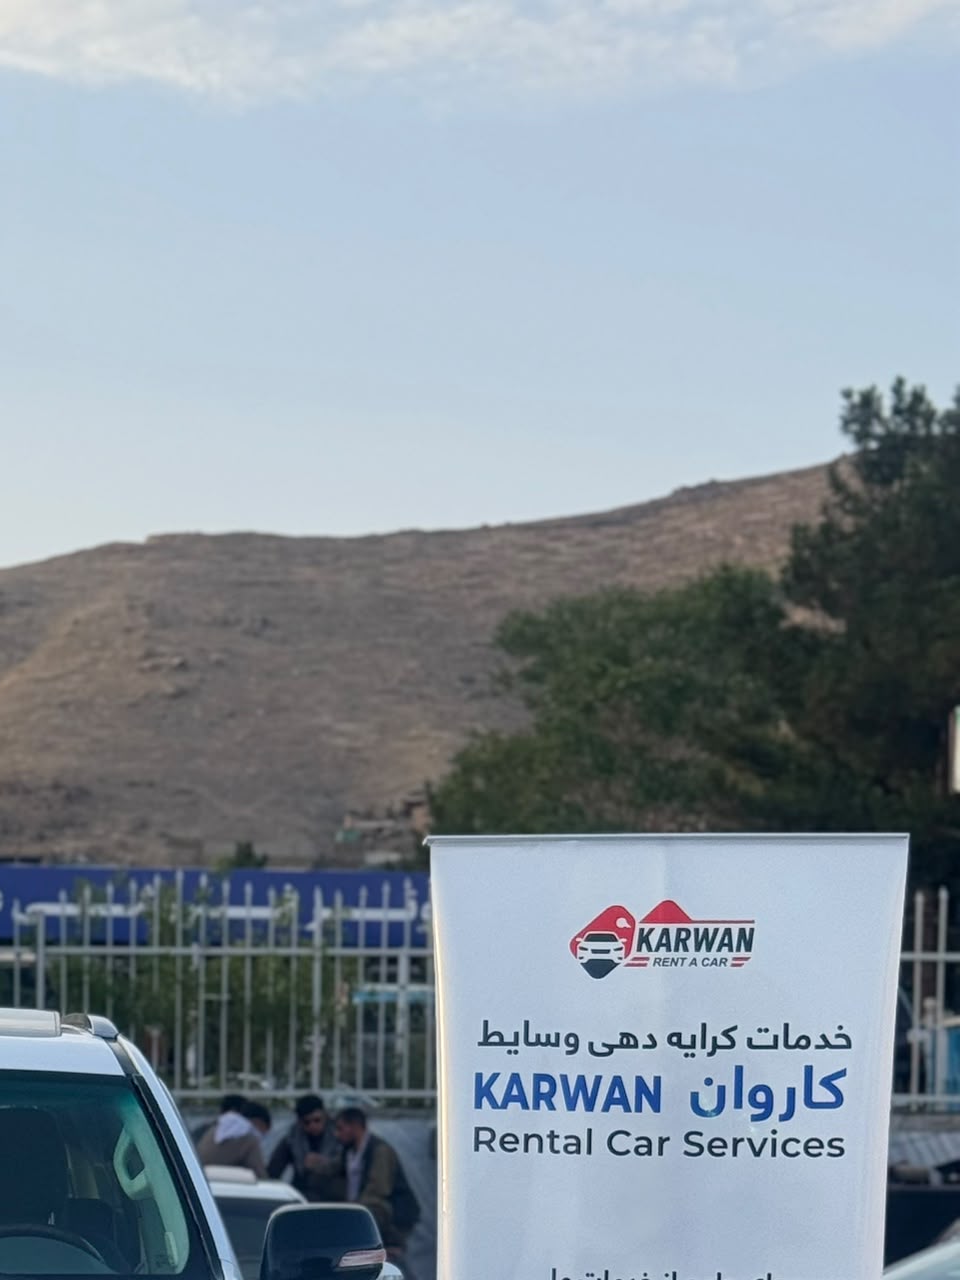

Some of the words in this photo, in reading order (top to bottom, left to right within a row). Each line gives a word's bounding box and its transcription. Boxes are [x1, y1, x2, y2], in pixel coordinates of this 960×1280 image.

[635, 927, 755, 953] KARWAN
[652, 956, 686, 968] RENT
[687, 956, 698, 968] A
[700, 956, 729, 968] CAR
[477, 1019, 580, 1056] وسایط
[587, 1031, 658, 1058] دهی
[666, 1022, 739, 1059] کرایه
[746, 1022, 853, 1051] خدمات
[473, 1071, 662, 1114] KARWAN
[689, 1064, 848, 1123] کاروان
[473, 1126, 593, 1156] Rental
[606, 1129, 671, 1157] Car
[682, 1128, 846, 1159] Services
